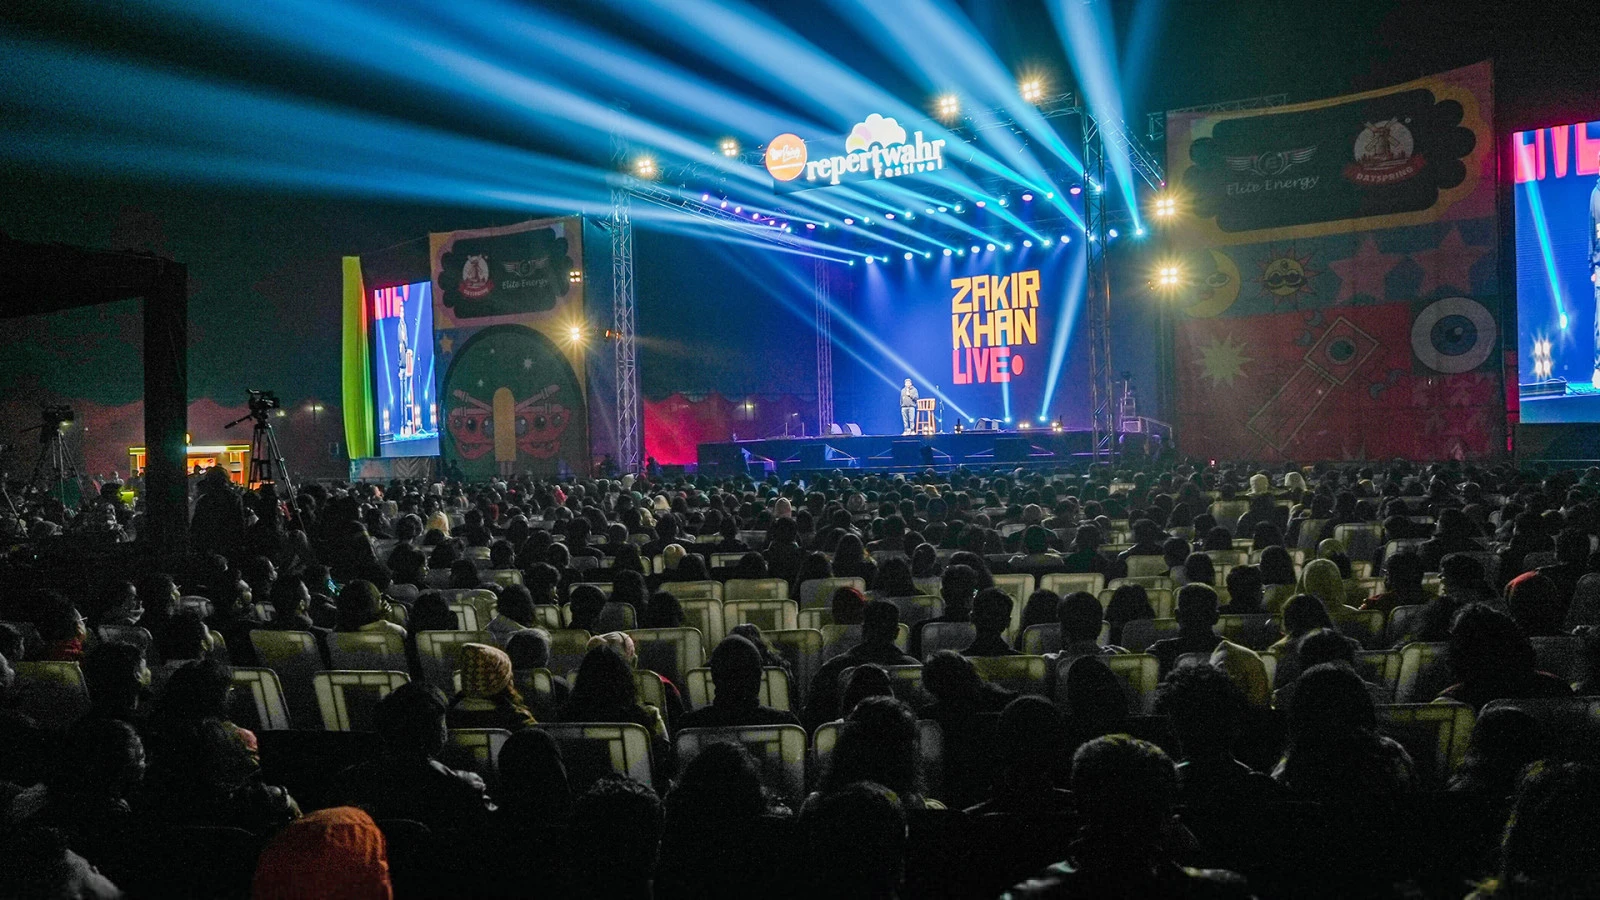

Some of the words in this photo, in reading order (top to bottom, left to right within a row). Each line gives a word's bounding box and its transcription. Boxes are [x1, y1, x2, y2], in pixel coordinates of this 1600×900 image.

[806, 131, 946, 185] repertwahr
[874, 158, 943, 180] Festival
[1356, 166, 1414, 183] DAYSPRING
[1226, 181, 1262, 196] Elite
[1264, 175, 1320, 191] Energy
[951, 270, 1041, 314] ZAKIR
[952, 307, 1037, 350] KHAN
[952, 346, 1011, 385] LIVE
